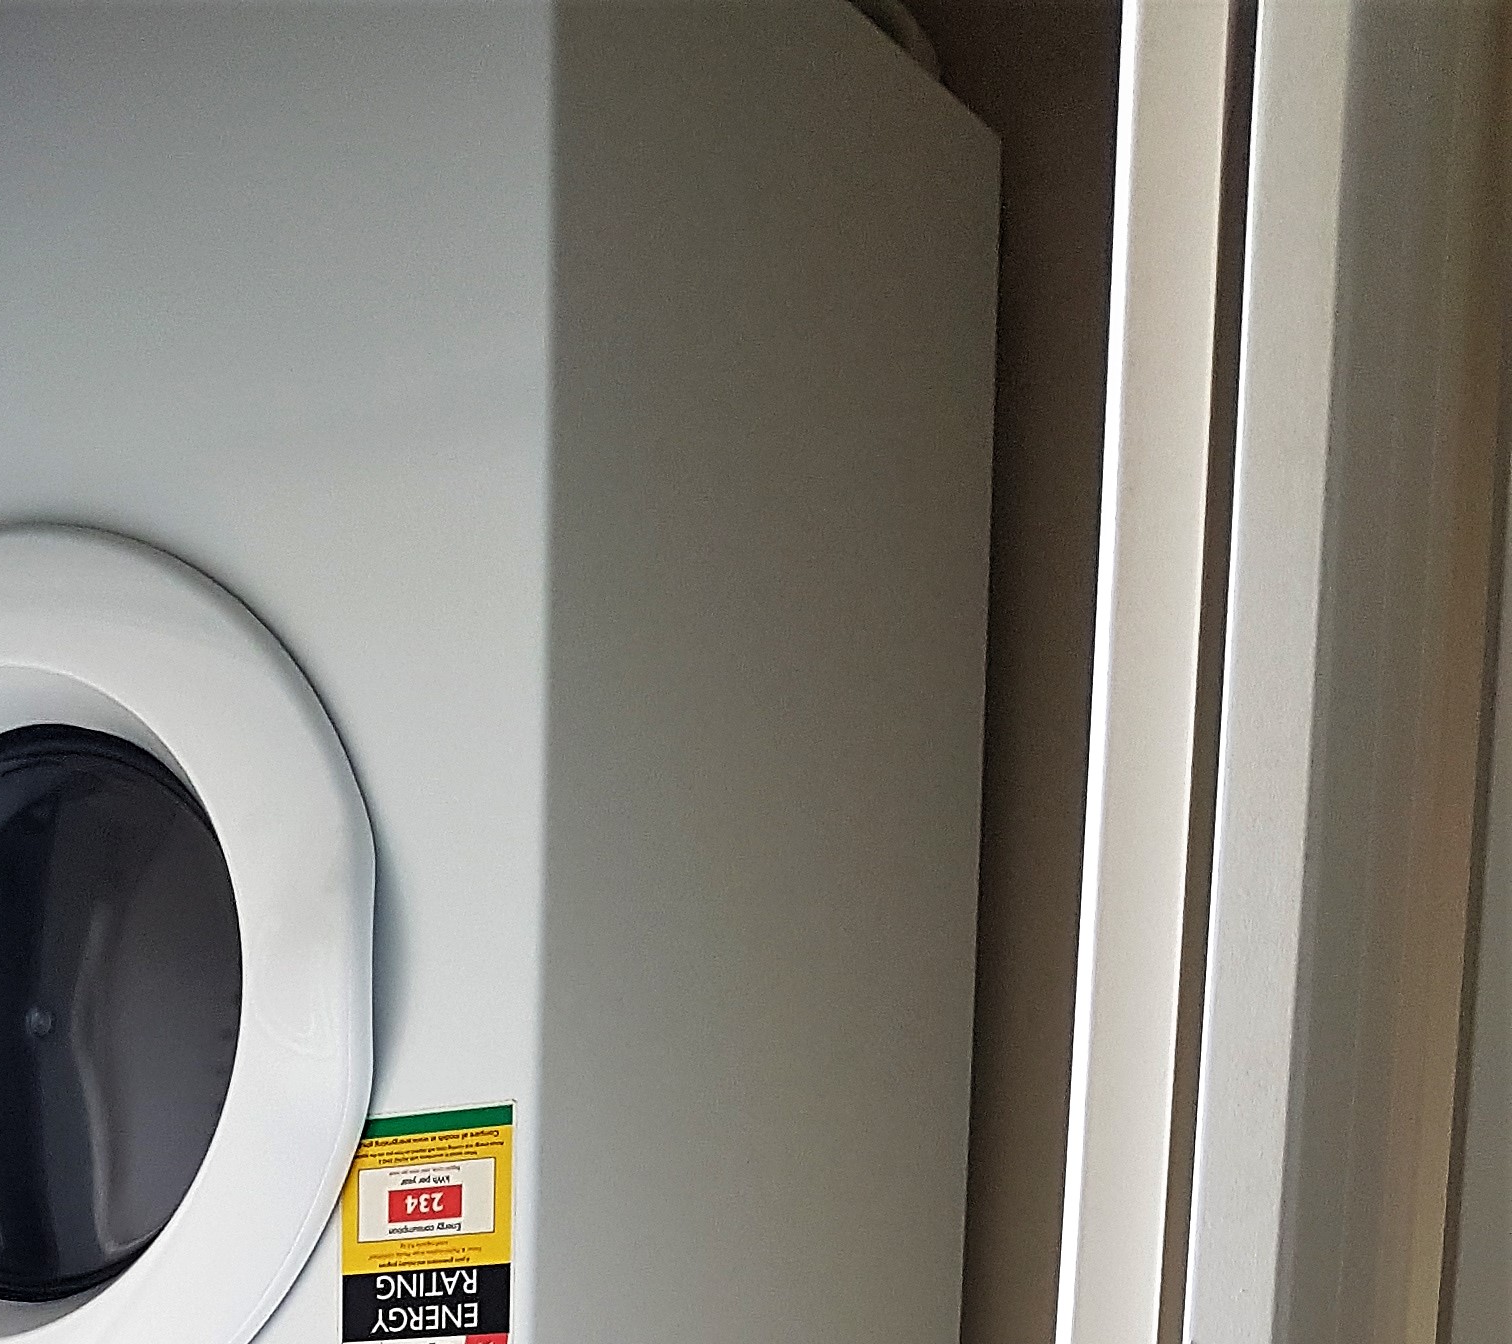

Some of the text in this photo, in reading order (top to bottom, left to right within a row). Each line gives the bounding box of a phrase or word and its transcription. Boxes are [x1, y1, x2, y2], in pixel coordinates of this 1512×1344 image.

[405, 1191, 444, 1215] 234
[376, 1269, 477, 1300] RATING
[370, 1302, 479, 1334] ENERGY
